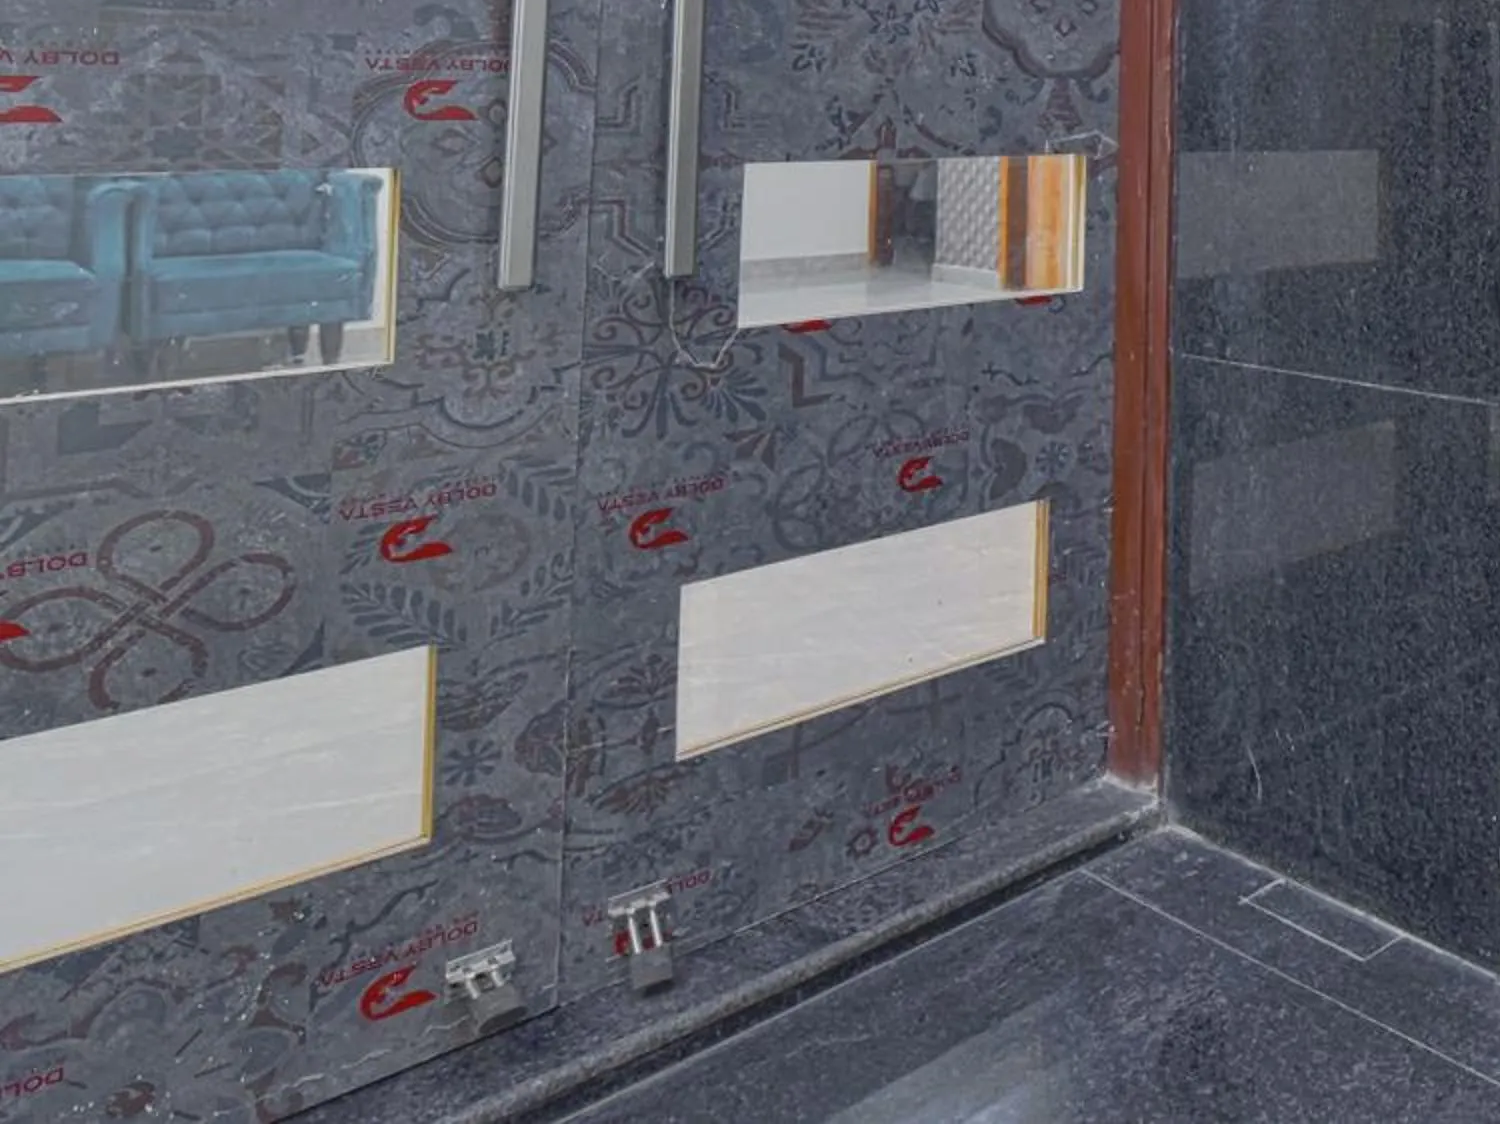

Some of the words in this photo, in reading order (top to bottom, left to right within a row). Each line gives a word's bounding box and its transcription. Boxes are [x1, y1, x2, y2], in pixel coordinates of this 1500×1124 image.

[23, 49, 119, 66] DOLBY
[365, 57, 440, 72] VESTA
[339, 496, 417, 521] VESTA
[429, 483, 497, 510] DOLBY
[0, 553, 87, 579] DOLB
[0, 1067, 64, 1097] DOL
